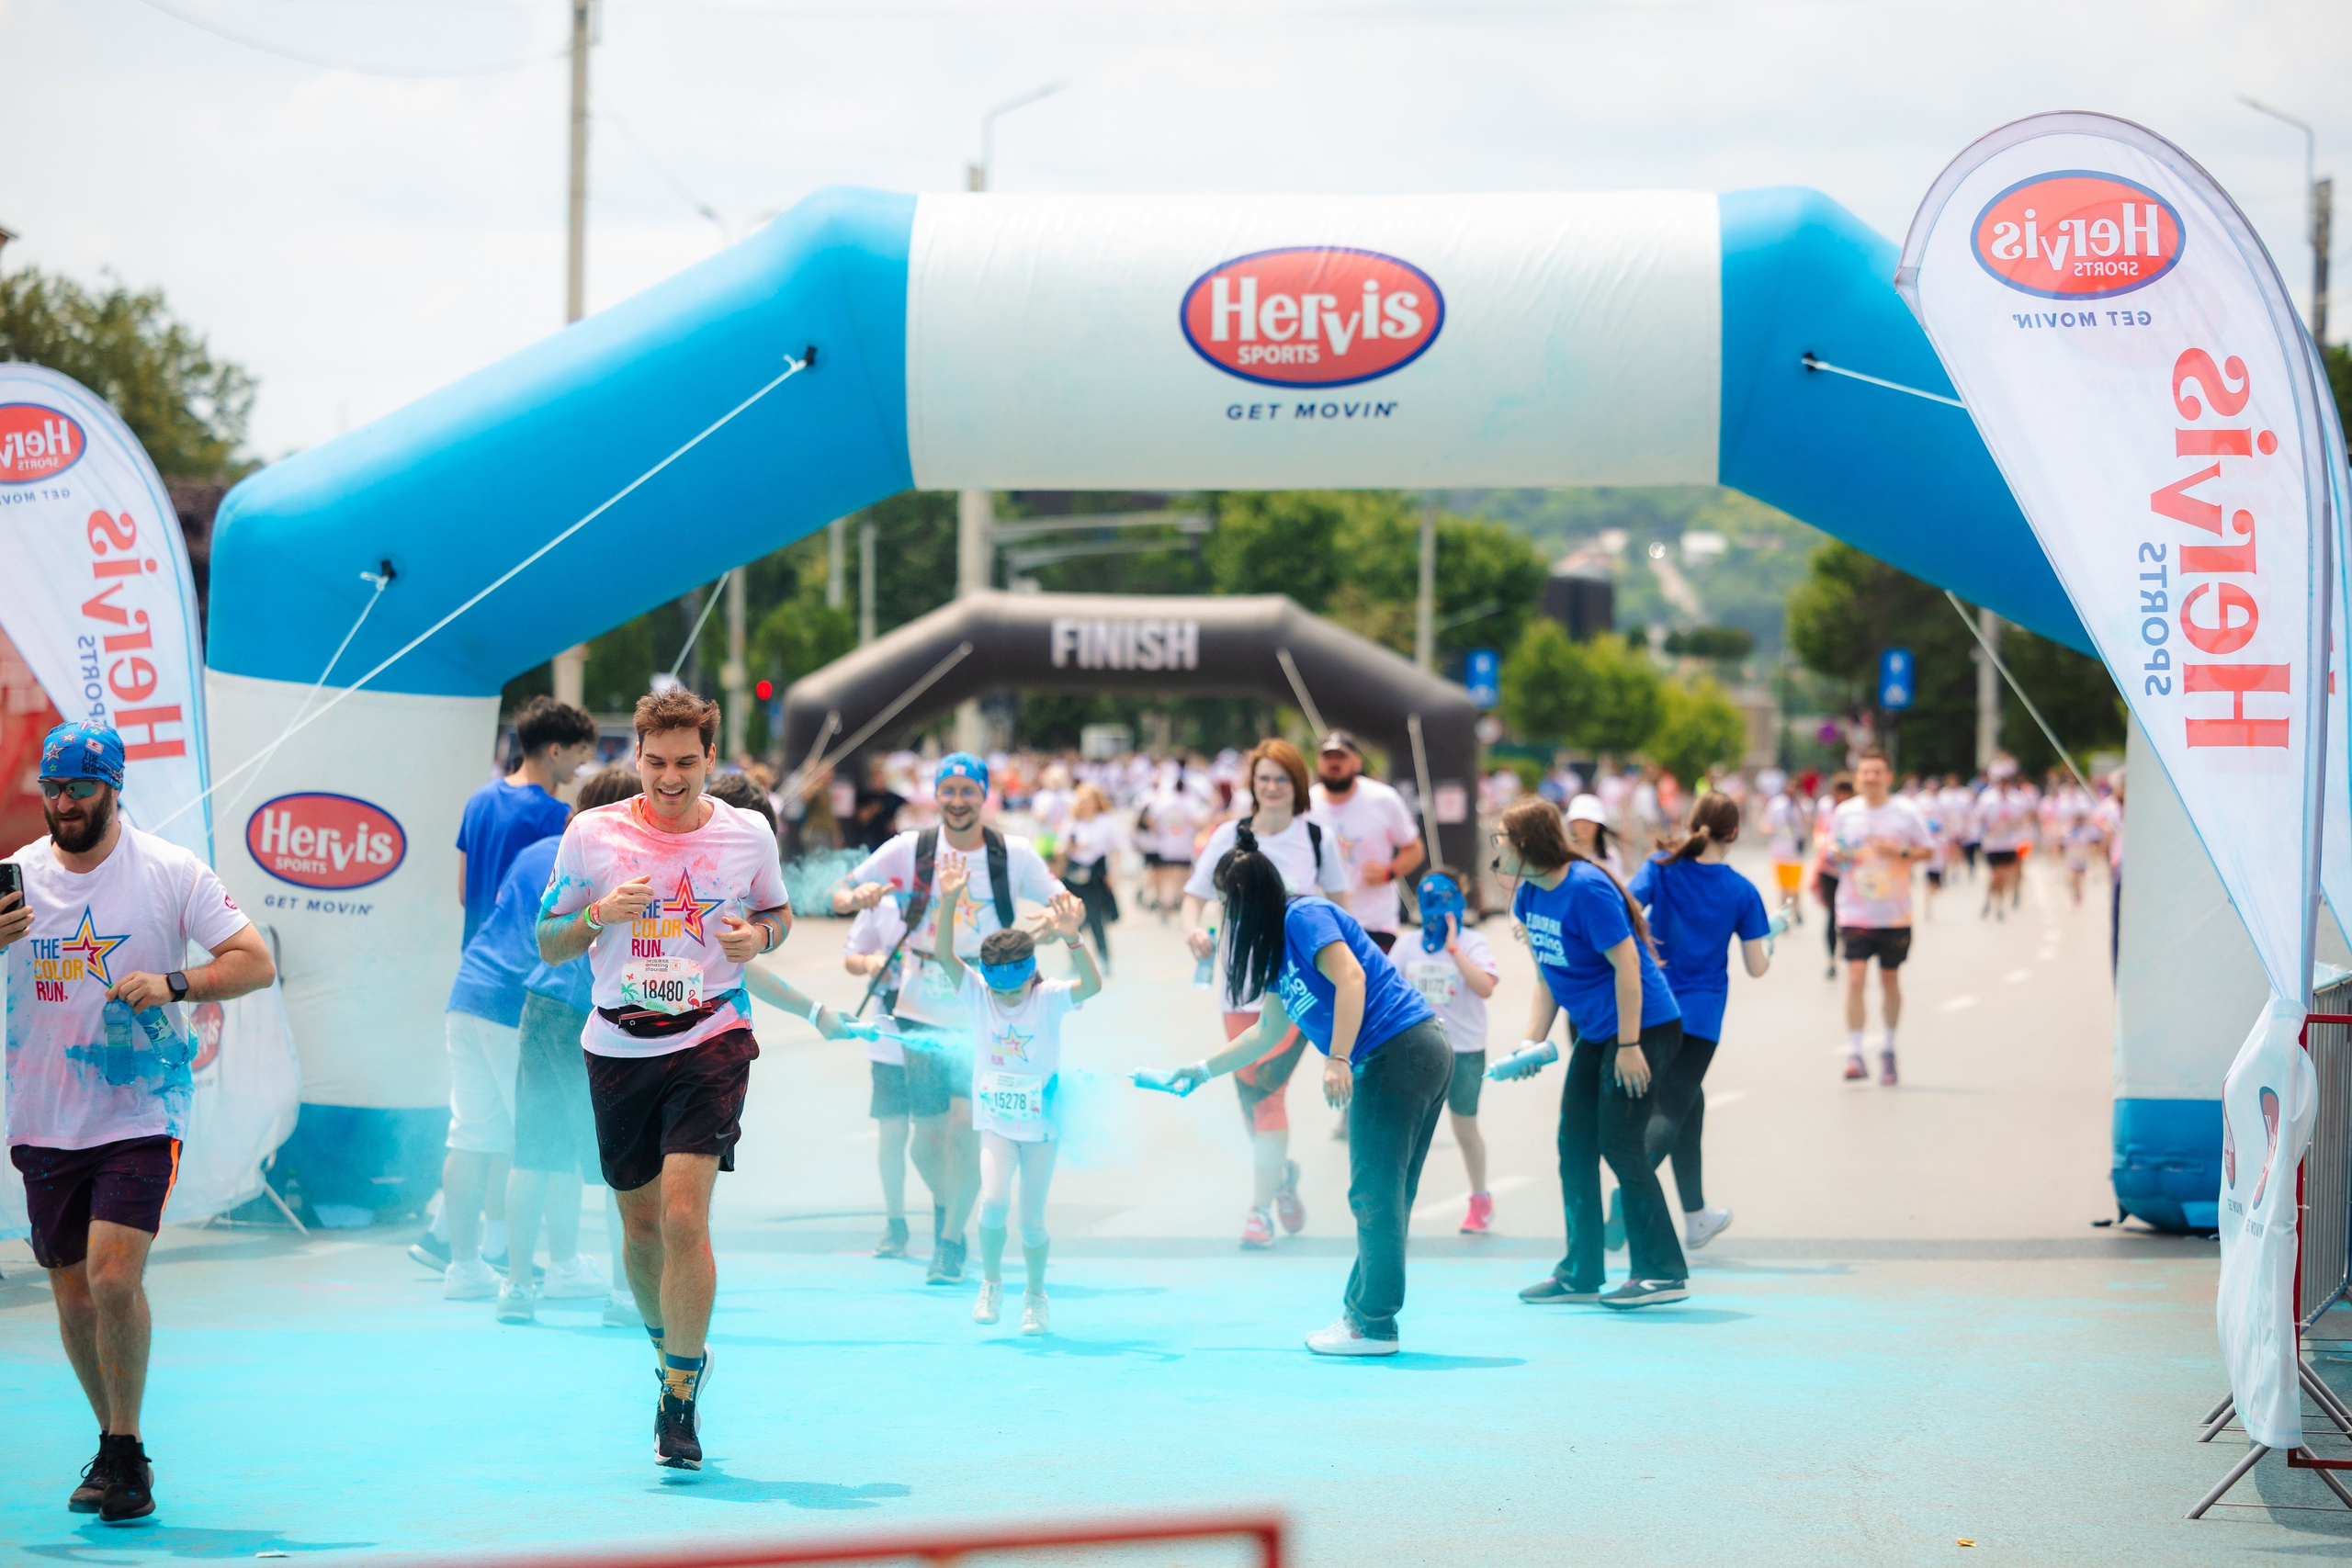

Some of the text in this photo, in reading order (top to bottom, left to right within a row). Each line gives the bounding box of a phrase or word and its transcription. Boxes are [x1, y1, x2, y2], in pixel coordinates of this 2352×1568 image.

[1210, 276, 1422, 355] Hervis
[1238, 344, 1320, 366] SPORTS
[1226, 403, 1283, 420] GET
[1050, 618, 1199, 671] FINISH
[261, 808, 393, 871] Hervis
[275, 856, 327, 874] SPORTS
[265, 894, 299, 909] GET
[642, 898, 661, 919] HE
[632, 919, 682, 939] COLOR
[30, 938, 60, 960] THE
[631, 938, 662, 957] RUN
[34, 959, 84, 981] COLOR
[36, 980, 63, 1002] RUN
[642, 979, 684, 1002] 18480
[994, 1091, 1026, 1110] 15278
